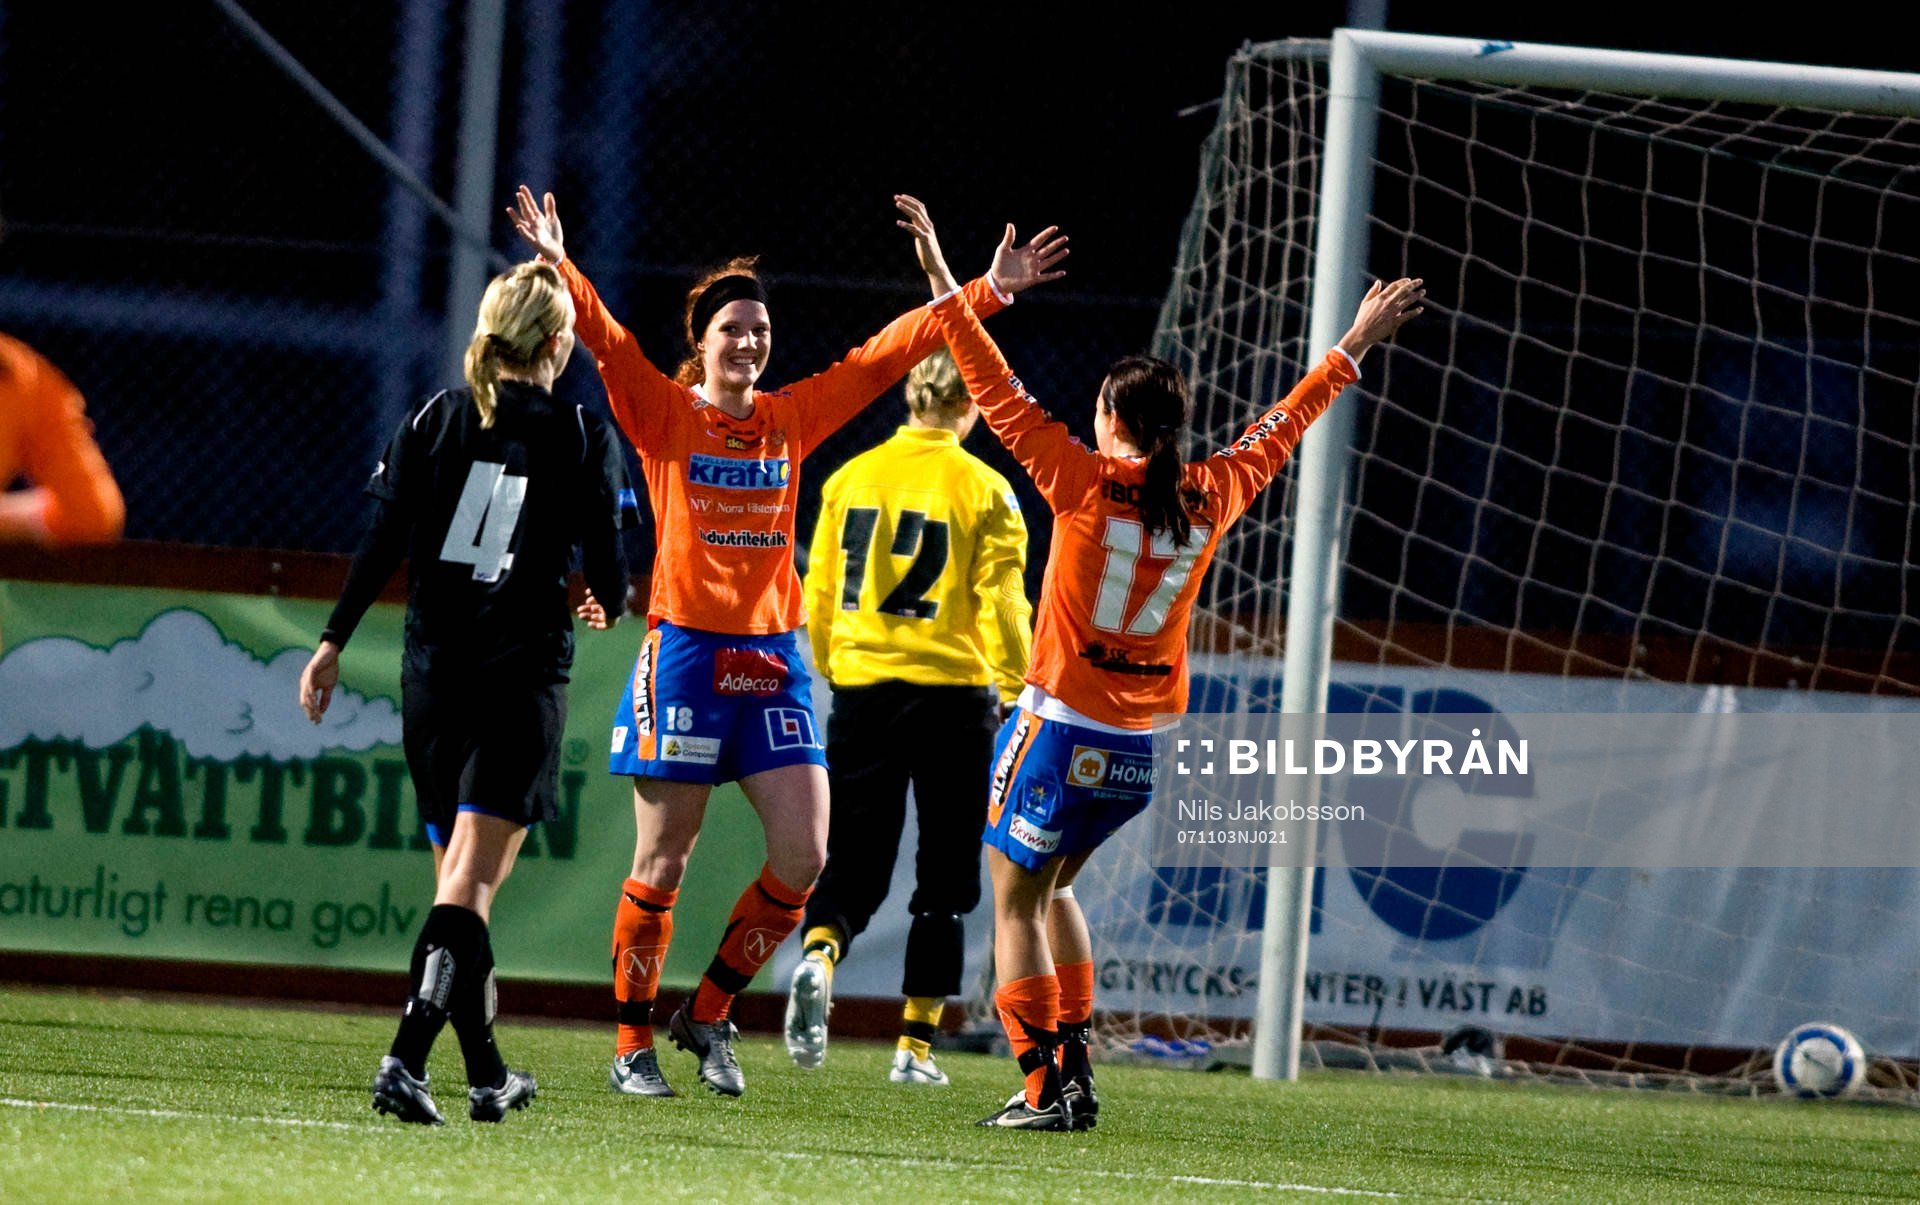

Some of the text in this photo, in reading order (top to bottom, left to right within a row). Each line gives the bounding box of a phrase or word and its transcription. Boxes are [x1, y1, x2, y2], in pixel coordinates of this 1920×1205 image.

[439, 460, 529, 583] 4
[841, 507, 949, 620] 12
[1090, 516, 1212, 636] 17
[635, 638, 655, 737] ALIMAK
[666, 706, 693, 732] 18
[719, 672, 779, 692] Adecco
[991, 715, 1031, 807] ALIMAK
[185, 893, 295, 932] rena
[311, 880, 418, 950] golv
[1304, 971, 1385, 1008] NTER
[1418, 971, 1496, 1014] VÄST
[1504, 984, 1548, 1017] AB
